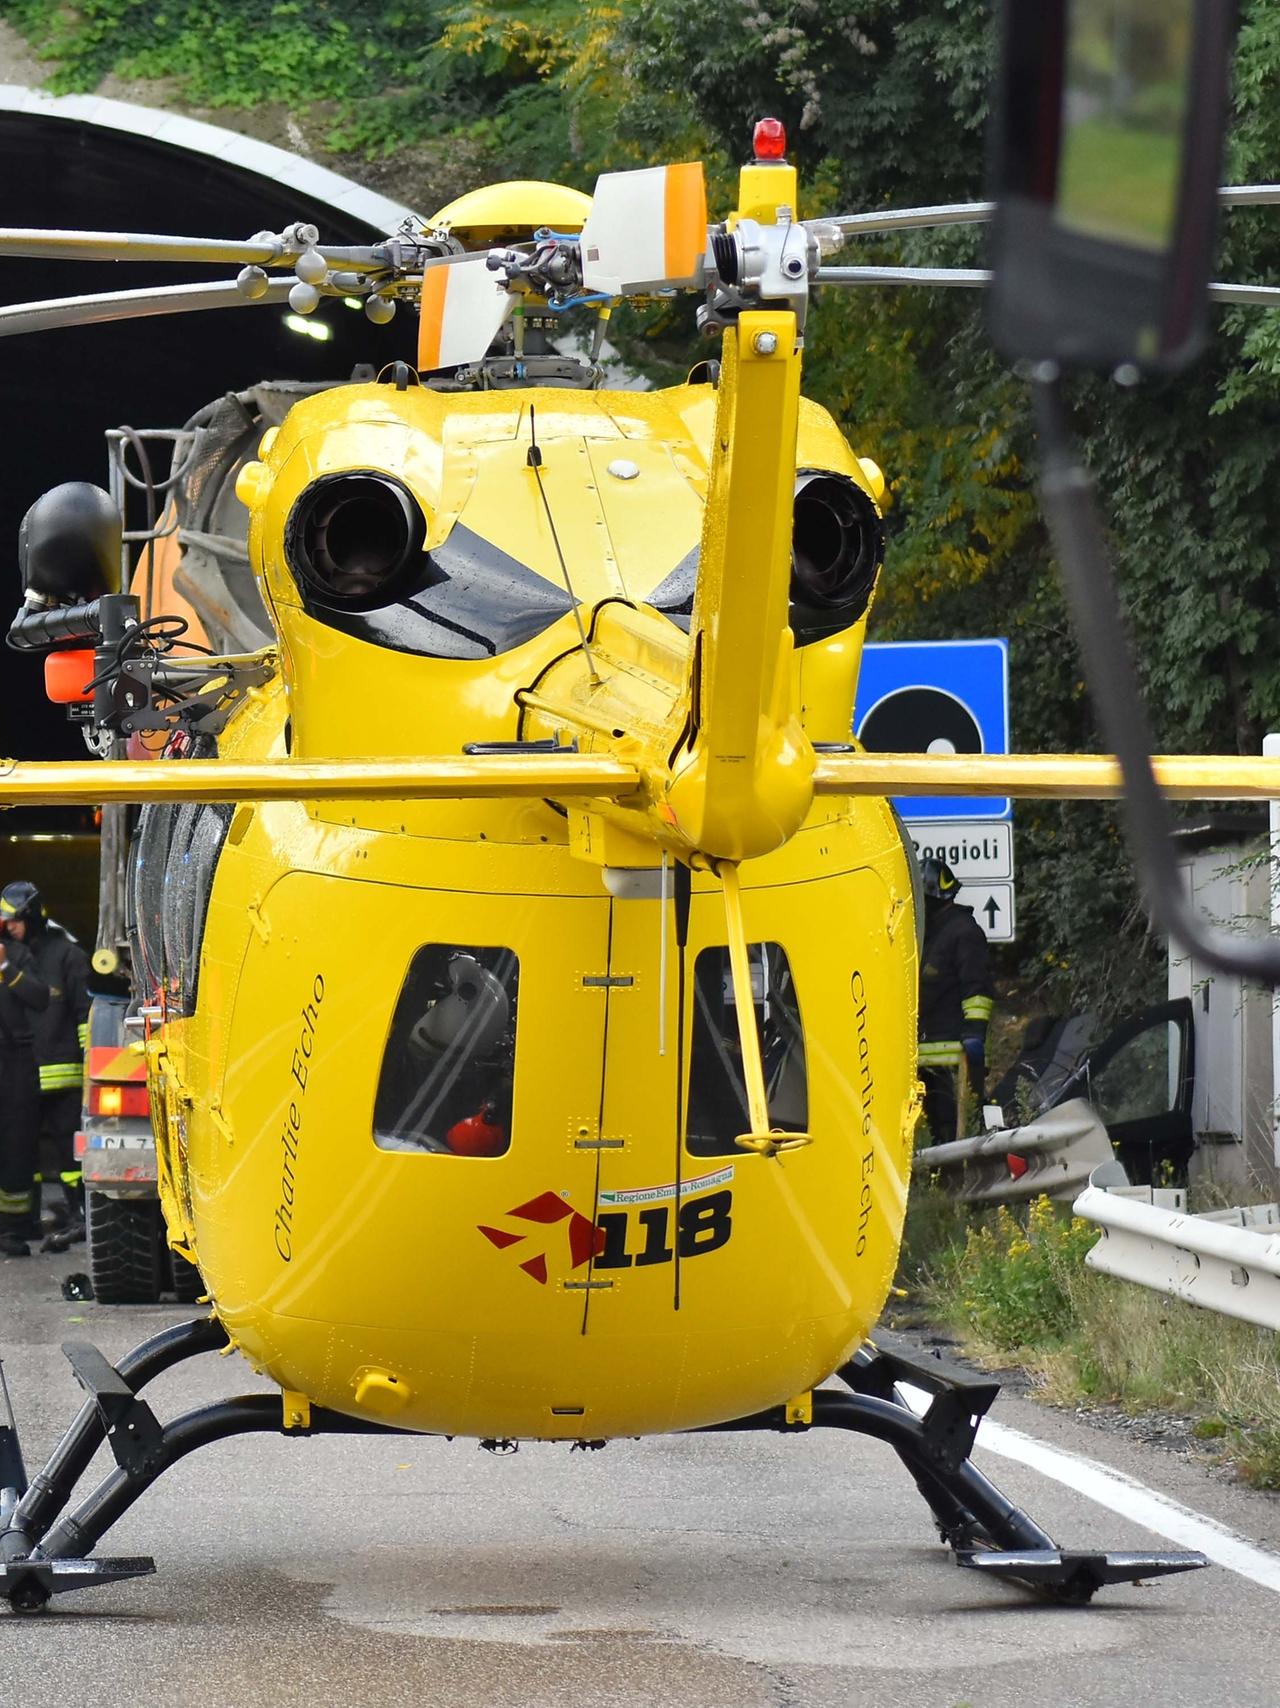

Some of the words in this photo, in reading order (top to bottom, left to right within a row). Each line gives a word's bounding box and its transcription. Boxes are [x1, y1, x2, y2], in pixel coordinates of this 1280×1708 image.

[274, 1102, 302, 1263] Charlie
[291, 974, 325, 1096] Echo
[851, 970, 874, 1137] Charlie
[593, 1190, 732, 1269] 118
[855, 1147, 875, 1258] Echo
